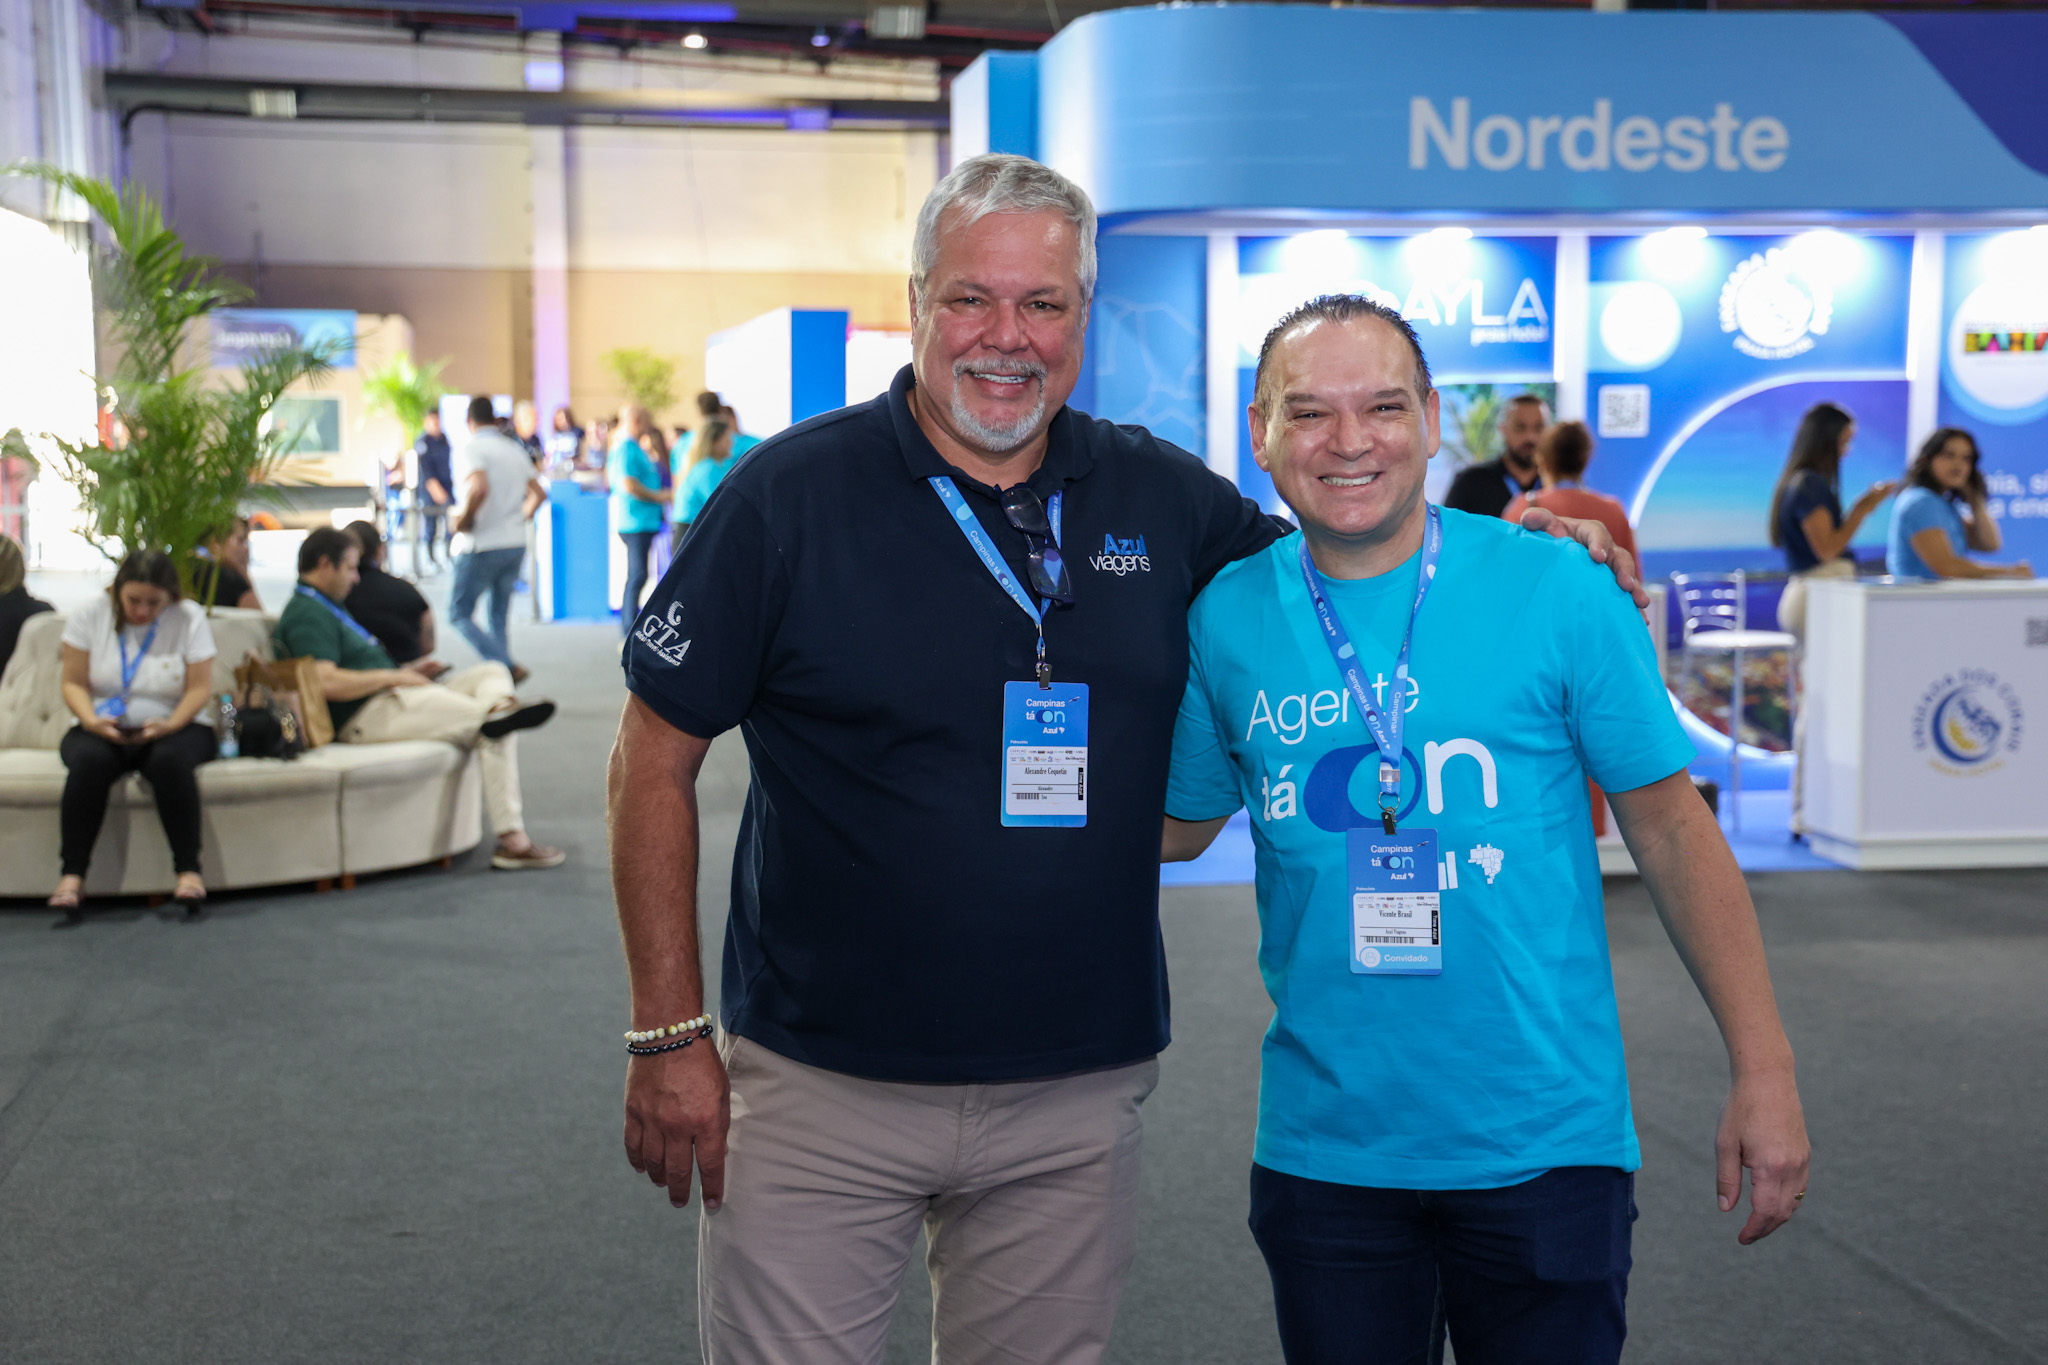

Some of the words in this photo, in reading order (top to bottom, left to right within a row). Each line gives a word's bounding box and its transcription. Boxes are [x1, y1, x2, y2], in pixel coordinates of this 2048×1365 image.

[1409, 96, 1790, 171] Nordeste
[970, 530, 996, 568] Campinas
[1104, 533, 1148, 555] Azul
[1089, 550, 1151, 576] viagens
[1302, 556, 1316, 591] Campinas
[642, 614, 692, 661] GTA
[1347, 668, 1367, 705] Campinas
[1026, 698, 1066, 708] Campinas
[1026, 711, 1035, 720] tá
[1042, 727, 1059, 735] Azul
[1025, 767, 1047, 775] Alexandre
[1261, 763, 1297, 822] tá
[1370, 845, 1413, 854] Campinas
[1371, 857, 1382, 867] tá
[1390, 872, 1407, 880] Azul
[1379, 910, 1396, 918] Vicente
